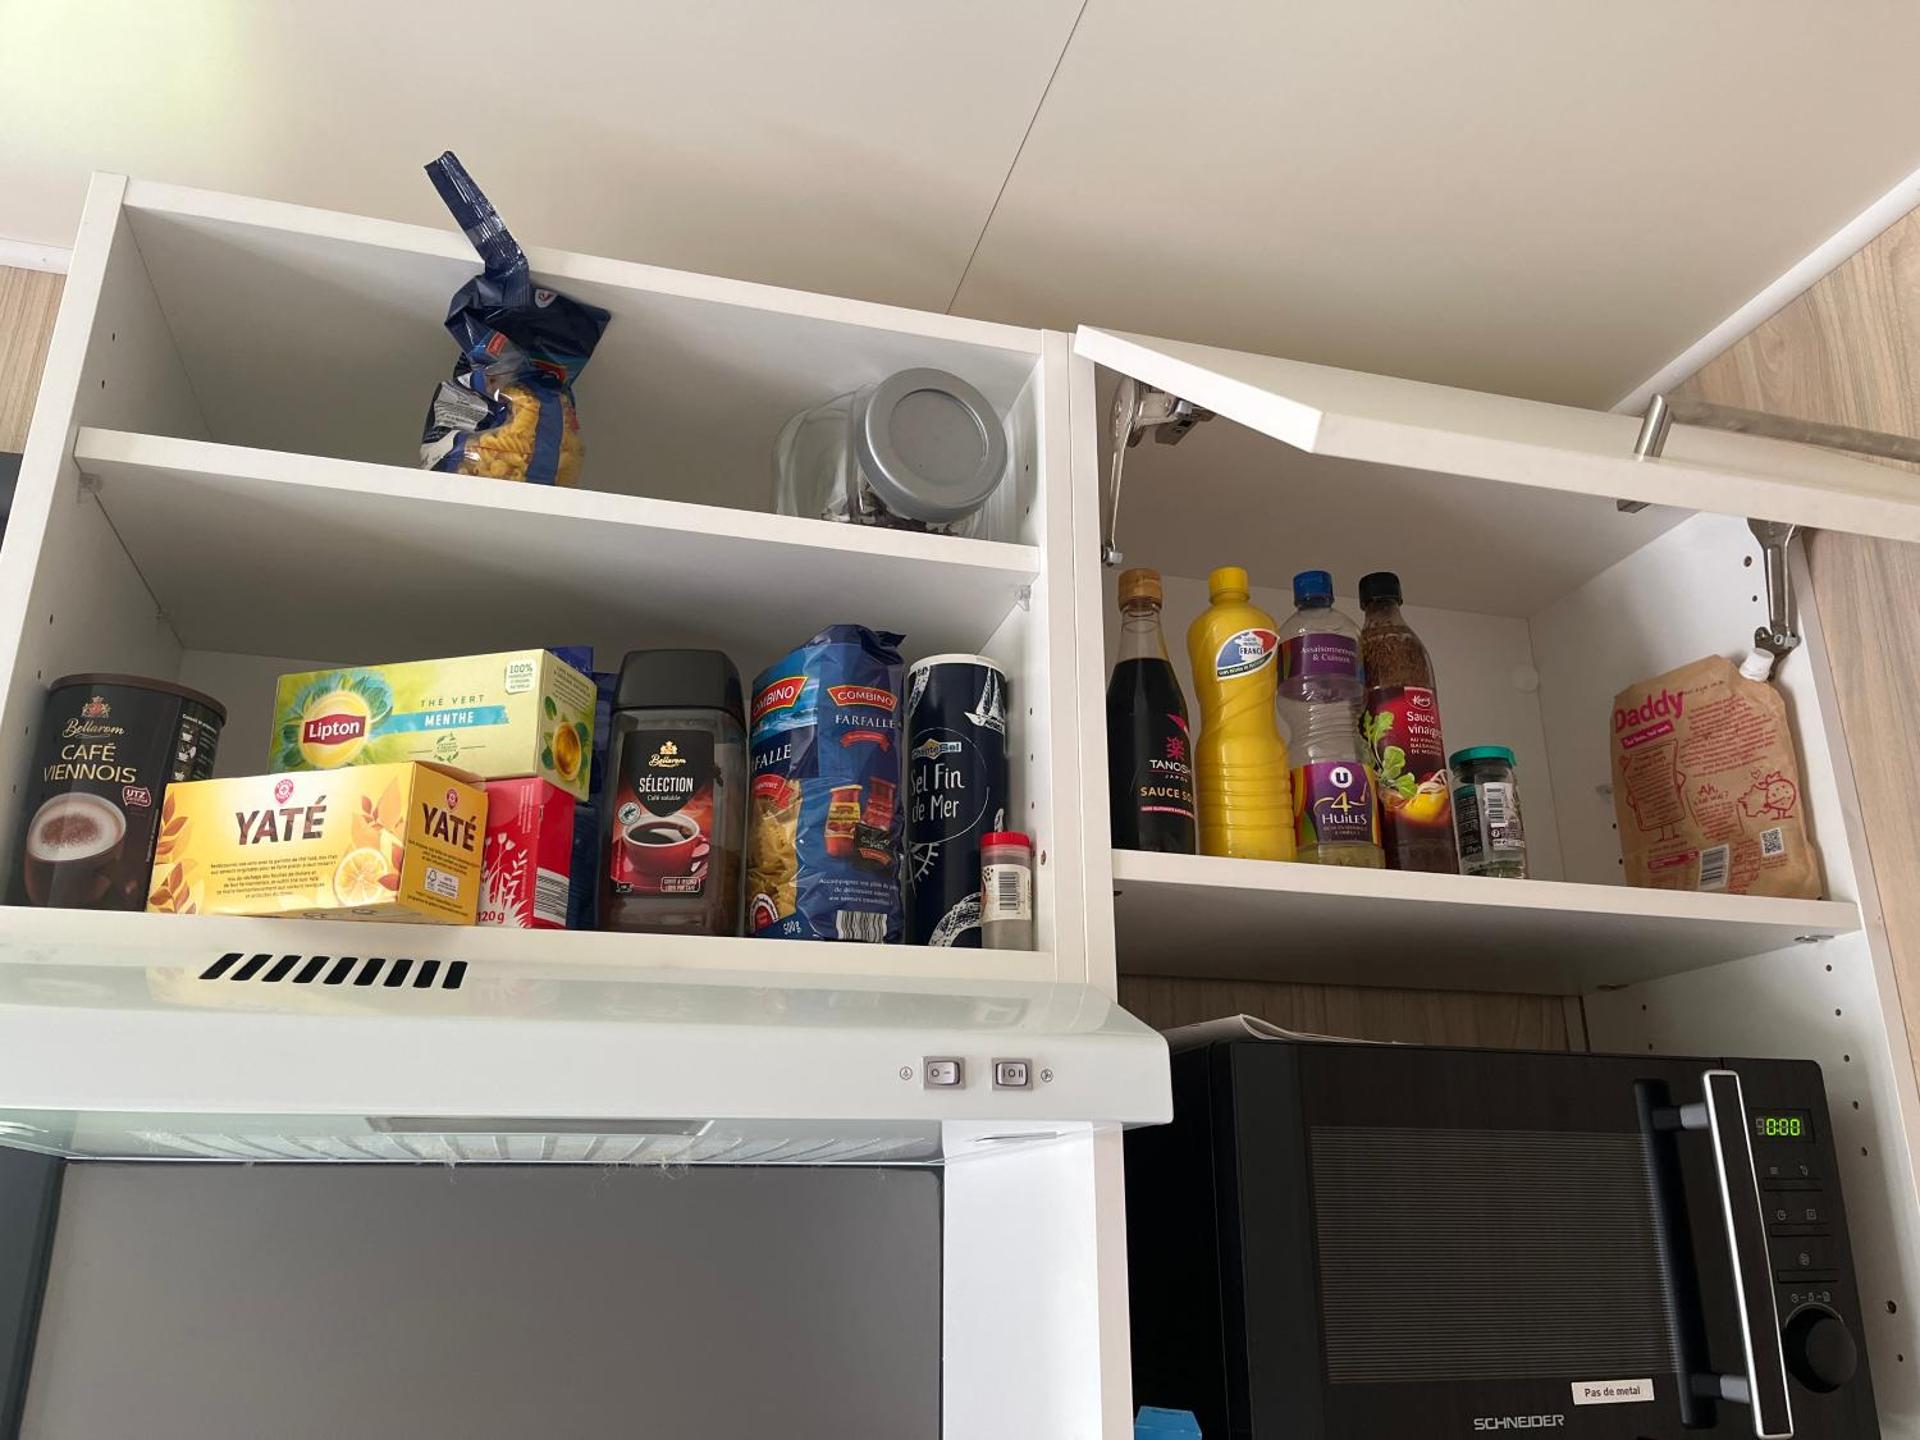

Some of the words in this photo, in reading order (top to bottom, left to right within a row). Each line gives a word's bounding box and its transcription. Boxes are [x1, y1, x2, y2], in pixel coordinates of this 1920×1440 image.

[451, 694, 485, 707] VERT
[837, 690, 893, 706] COMBINO
[424, 711, 475, 728] MENTHE
[1406, 710, 1435, 724] Sauce
[1614, 689, 1684, 731] Daddy
[62, 719, 125, 738] Bellarom
[309, 720, 361, 740] Lipton
[835, 714, 896, 729] FARFALLE
[61, 743, 117, 762] CAFÉ
[44, 763, 137, 784] VIENNOIS
[935, 763, 966, 790] Fin
[639, 774, 694, 793] SÉLECTION
[1140, 786, 1180, 798] SAUCE
[126, 789, 147, 800] UTZ
[1331, 791, 1353, 813] 4
[912, 796, 925, 823] de
[930, 793, 960, 821] Mer
[235, 794, 328, 846] YATÉ
[422, 802, 477, 852] YATÉ
[1766, 1118, 1801, 1136] 0:00
[1584, 1387, 1602, 1398] Pas
[1603, 1387, 1615, 1397] de
[1616, 1386, 1641, 1396] metal
[1473, 1414, 1565, 1431] SCHNEIDER
